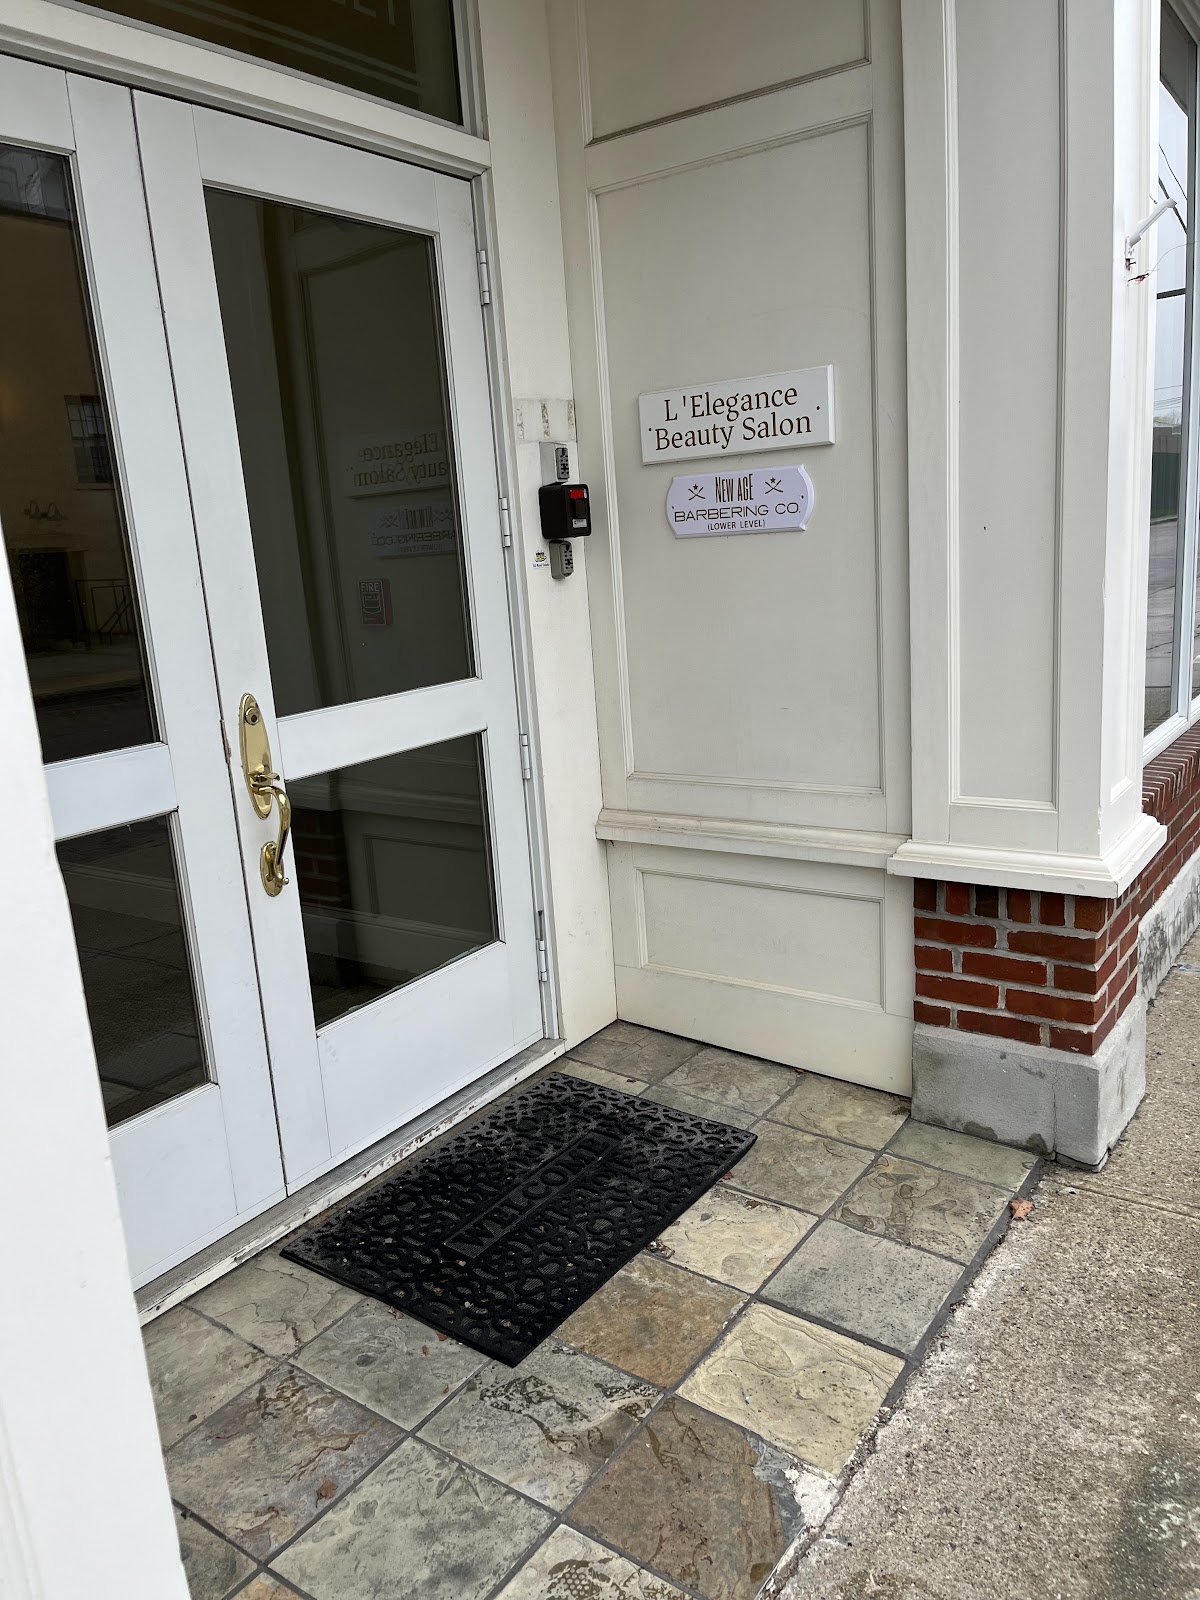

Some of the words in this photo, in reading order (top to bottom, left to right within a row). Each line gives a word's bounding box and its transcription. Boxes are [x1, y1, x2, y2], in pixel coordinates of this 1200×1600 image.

[655, 422, 734, 450] Beauty
[742, 412, 812, 441] Salon
[715, 476, 734, 503] NEW
[737, 474, 754, 501] AGE
[674, 505, 769, 522] BARBERING
[707, 521, 737, 531] (LOWER
[740, 519, 766, 530] LEVEL)
[361, 582, 380, 592] FIRE
[451, 1137, 611, 1247] WELCOME
